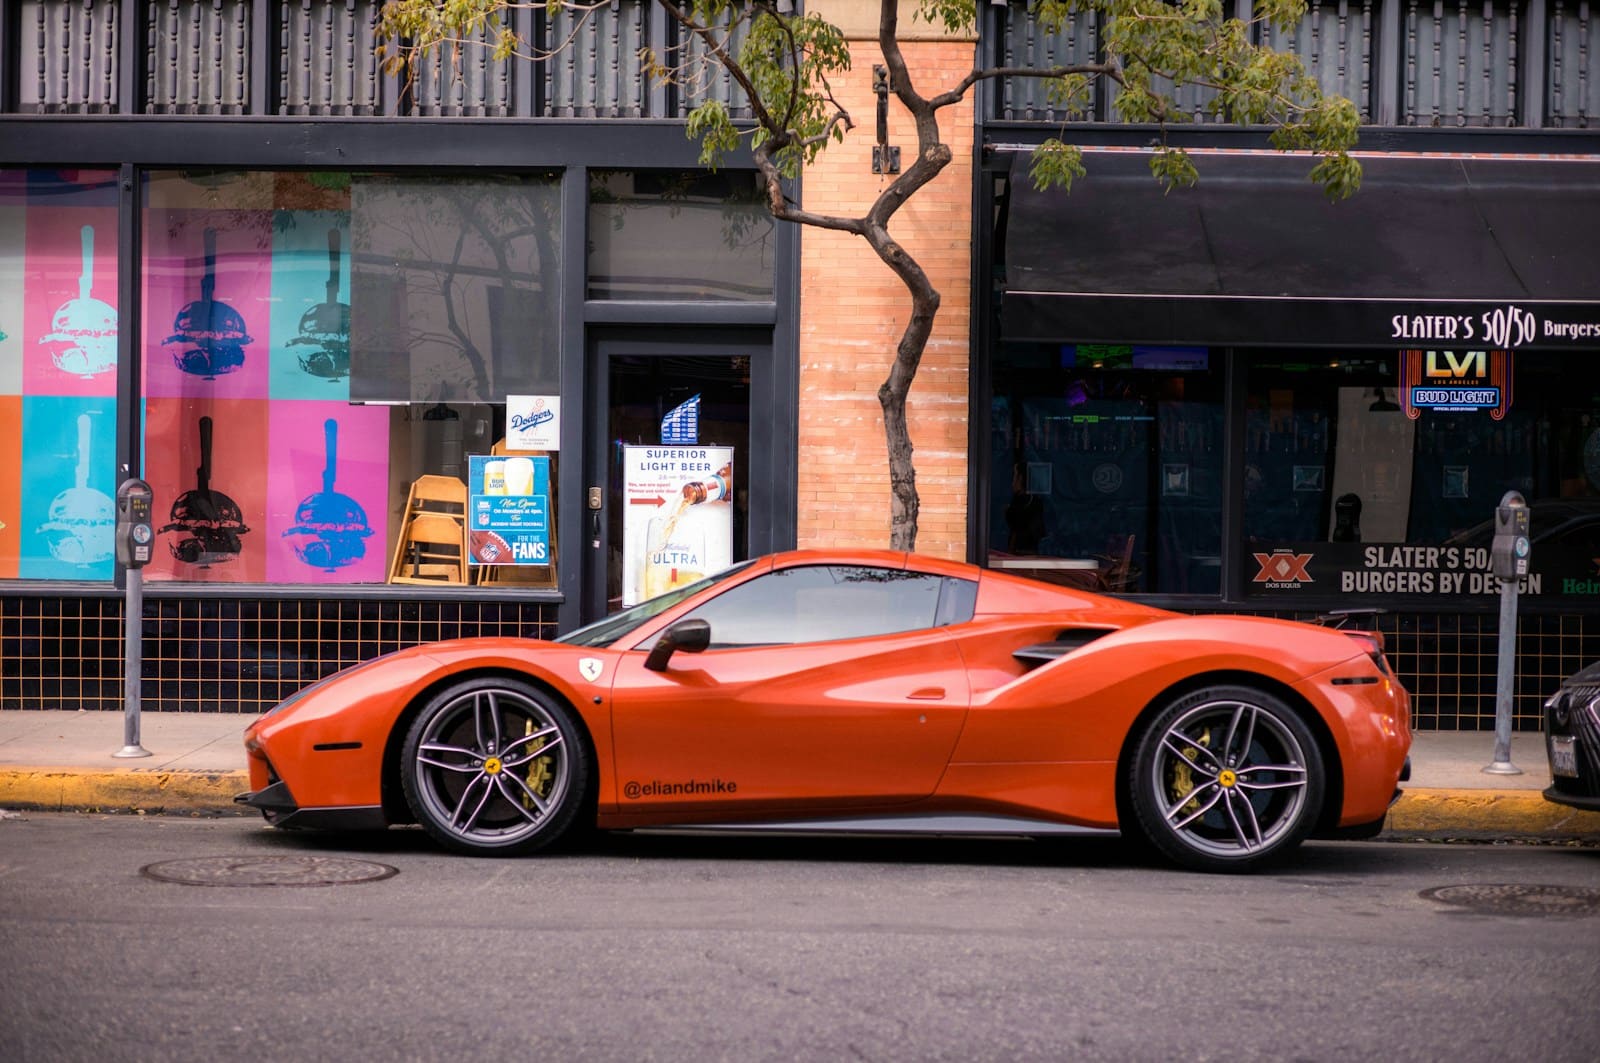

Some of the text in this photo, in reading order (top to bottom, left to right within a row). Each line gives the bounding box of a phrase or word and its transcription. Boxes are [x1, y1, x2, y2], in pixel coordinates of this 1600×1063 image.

[1391, 305, 1600, 348] SLATER'S 50/50 Burgers
[1426, 350, 1486, 377] LVI
[1416, 391, 1495, 404] BUD LIGHT
[511, 409, 553, 432] Dodgers
[646, 450, 706, 459] SUPERIOR
[640, 462, 711, 471] LIGHT BEER
[499, 498, 516, 508] Now
[512, 542, 545, 559] FANS
[653, 553, 698, 565] ULTRA
[1364, 547, 1459, 568] SLATER'S
[1341, 571, 1541, 594] BURGERS BY DESGN
[624, 779, 737, 800] @eliandmike
